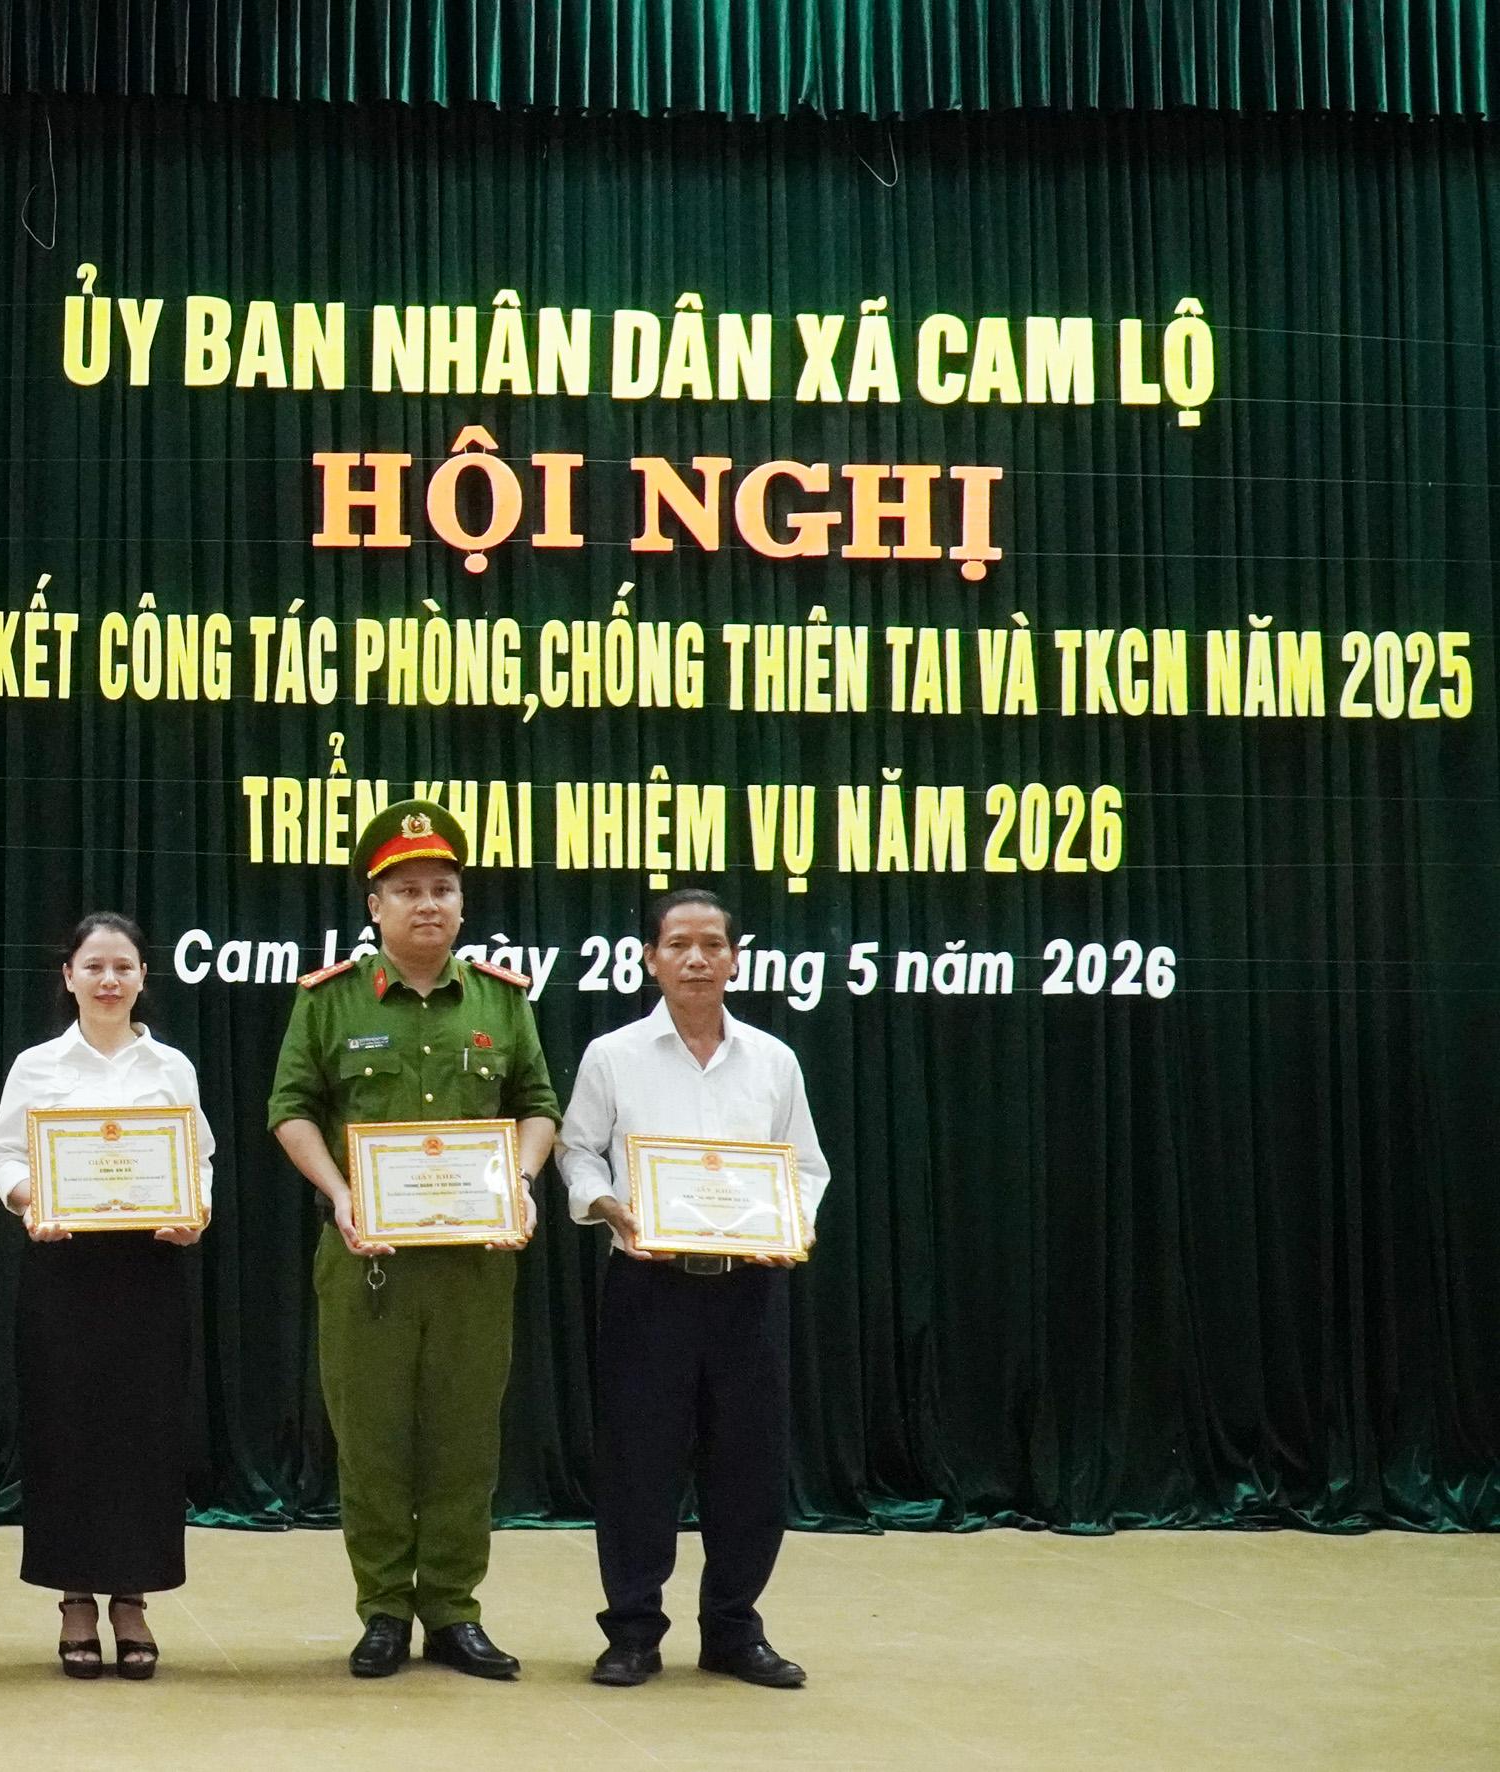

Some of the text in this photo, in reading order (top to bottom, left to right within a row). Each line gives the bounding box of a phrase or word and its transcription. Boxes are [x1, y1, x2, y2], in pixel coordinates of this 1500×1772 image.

[64, 263, 1213, 426] ỦY BAN NHÂN DÂN XÃ CAM LỘ
[313, 426, 1003, 581] HỘI NGHỊ
[100, 593, 231, 700] CÔNG
[250, 599, 337, 704] TÁC
[723, 606, 868, 712] THIÊN
[886, 627, 961, 714] TAI
[978, 612, 1037, 715] VÀ
[1055, 628, 1187, 715] TKCN
[1207, 614, 1325, 716] NĂM
[1340, 631, 1472, 718] 2025
[412, 780, 531, 867] HAI
[557, 765, 725, 889] NHIỆM
[748, 785, 815, 892] VỤ
[838, 768, 966, 872] NĂM
[985, 783, 1122, 872] 2026
[174, 928, 299, 984] Cam
[579, 936, 643, 993] 28
[847, 942, 878, 995] 5
[896, 940, 1013, 994] năm
[1043, 939, 1175, 998] 2026
